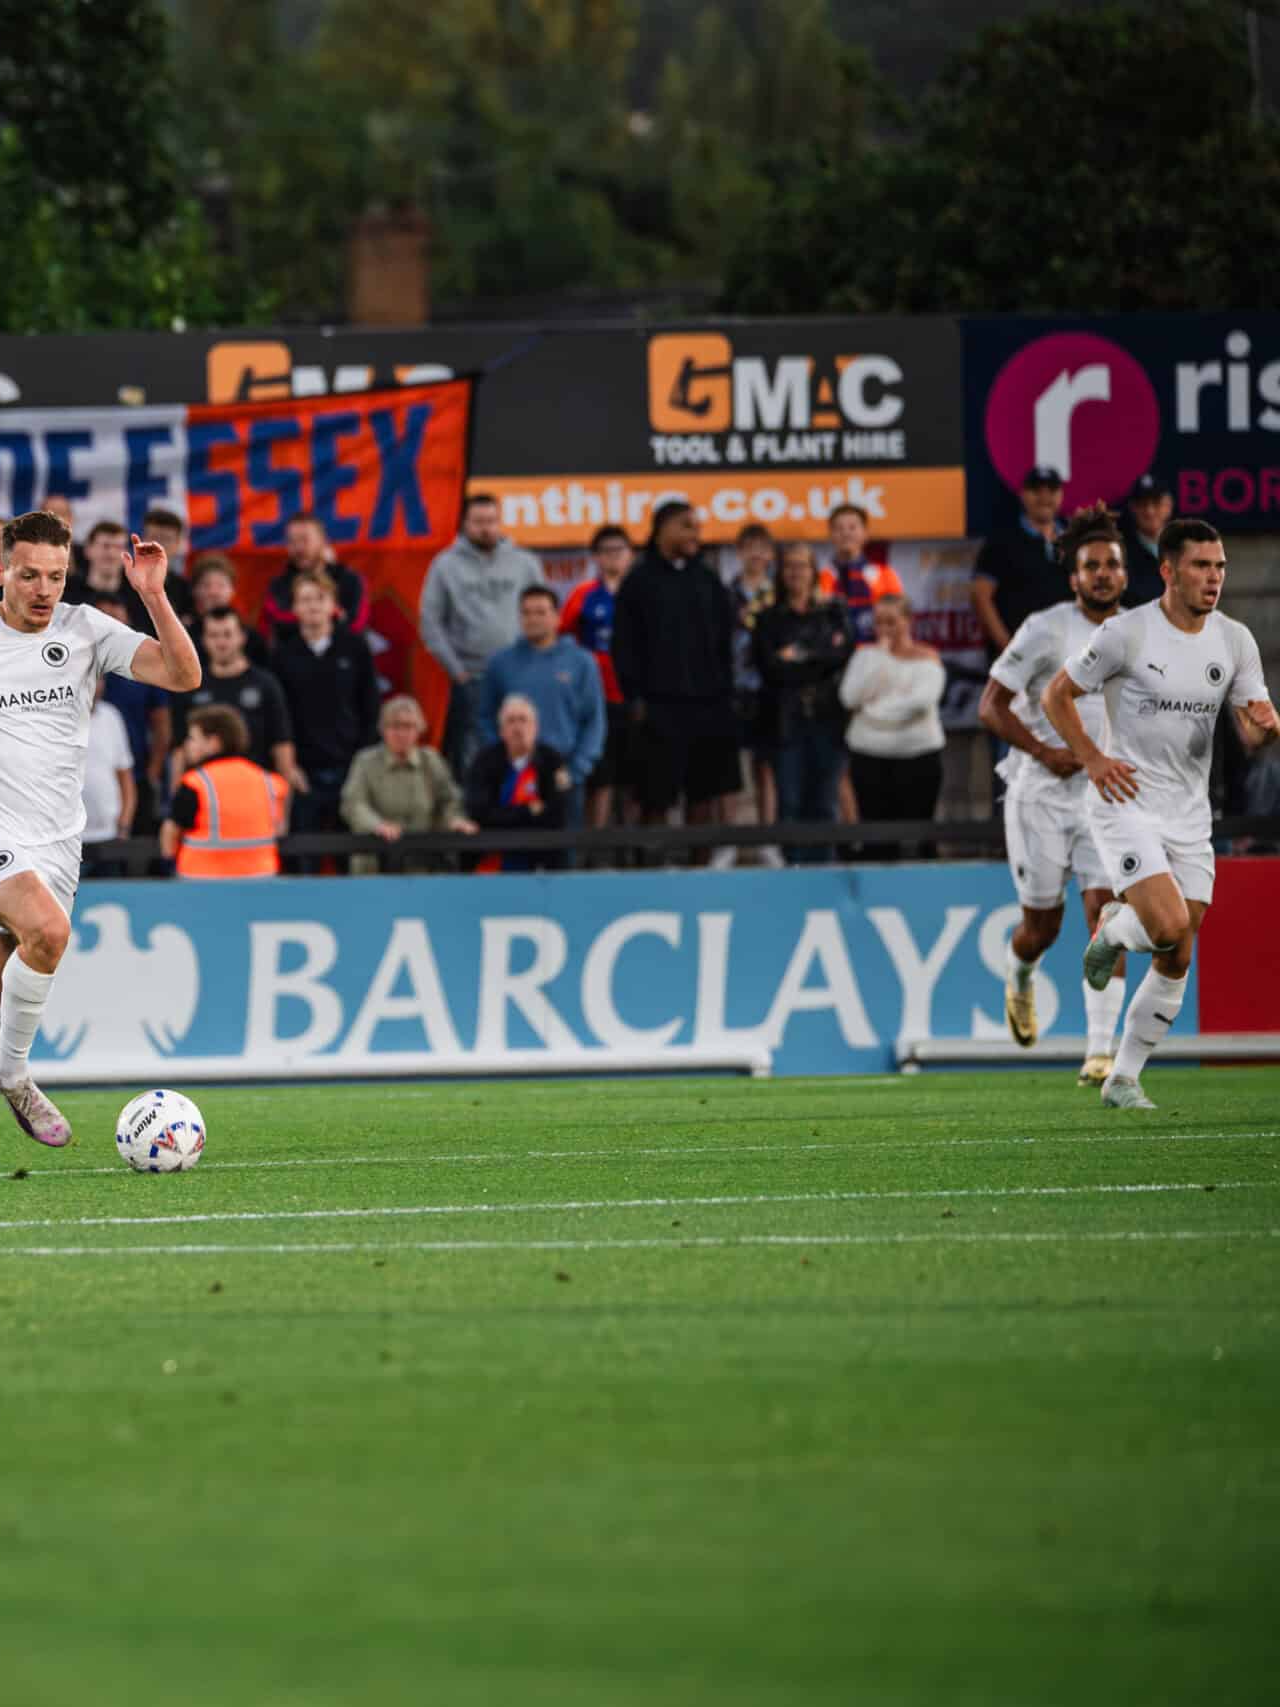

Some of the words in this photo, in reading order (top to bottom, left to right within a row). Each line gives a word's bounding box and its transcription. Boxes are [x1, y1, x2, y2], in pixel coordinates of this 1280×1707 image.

[648, 332, 905, 432] GMAC
[125, 403, 433, 552] ESSEX
[650, 433, 720, 465] TOOL
[751, 431, 836, 462] PLANT
[842, 429, 906, 460] HIRE
